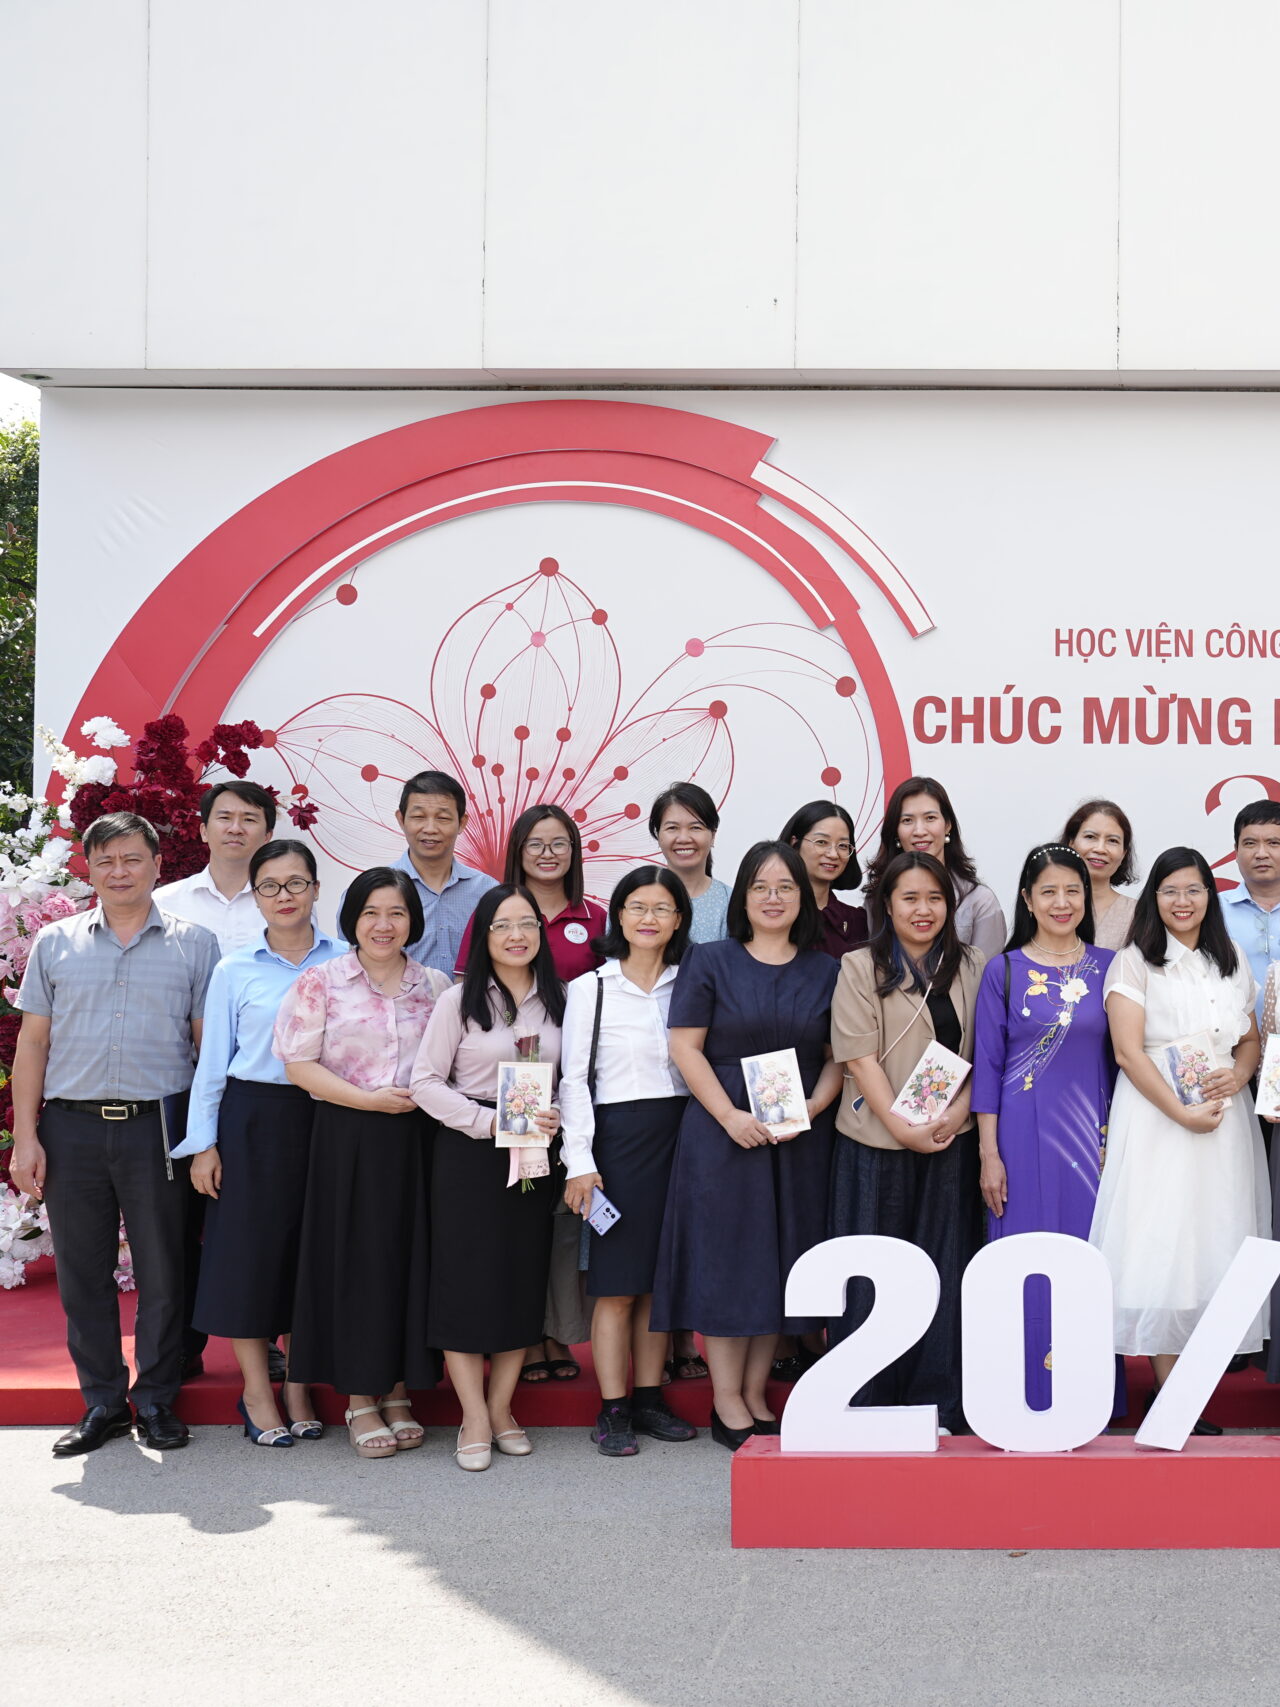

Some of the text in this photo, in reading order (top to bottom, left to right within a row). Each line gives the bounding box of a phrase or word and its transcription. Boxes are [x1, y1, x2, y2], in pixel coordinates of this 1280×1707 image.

[1055, 627, 1117, 663] HỌC
[1125, 622, 1194, 664] VIỆN
[912, 684, 1063, 745] CHÚC
[1083, 685, 1252, 747] MỪNG
